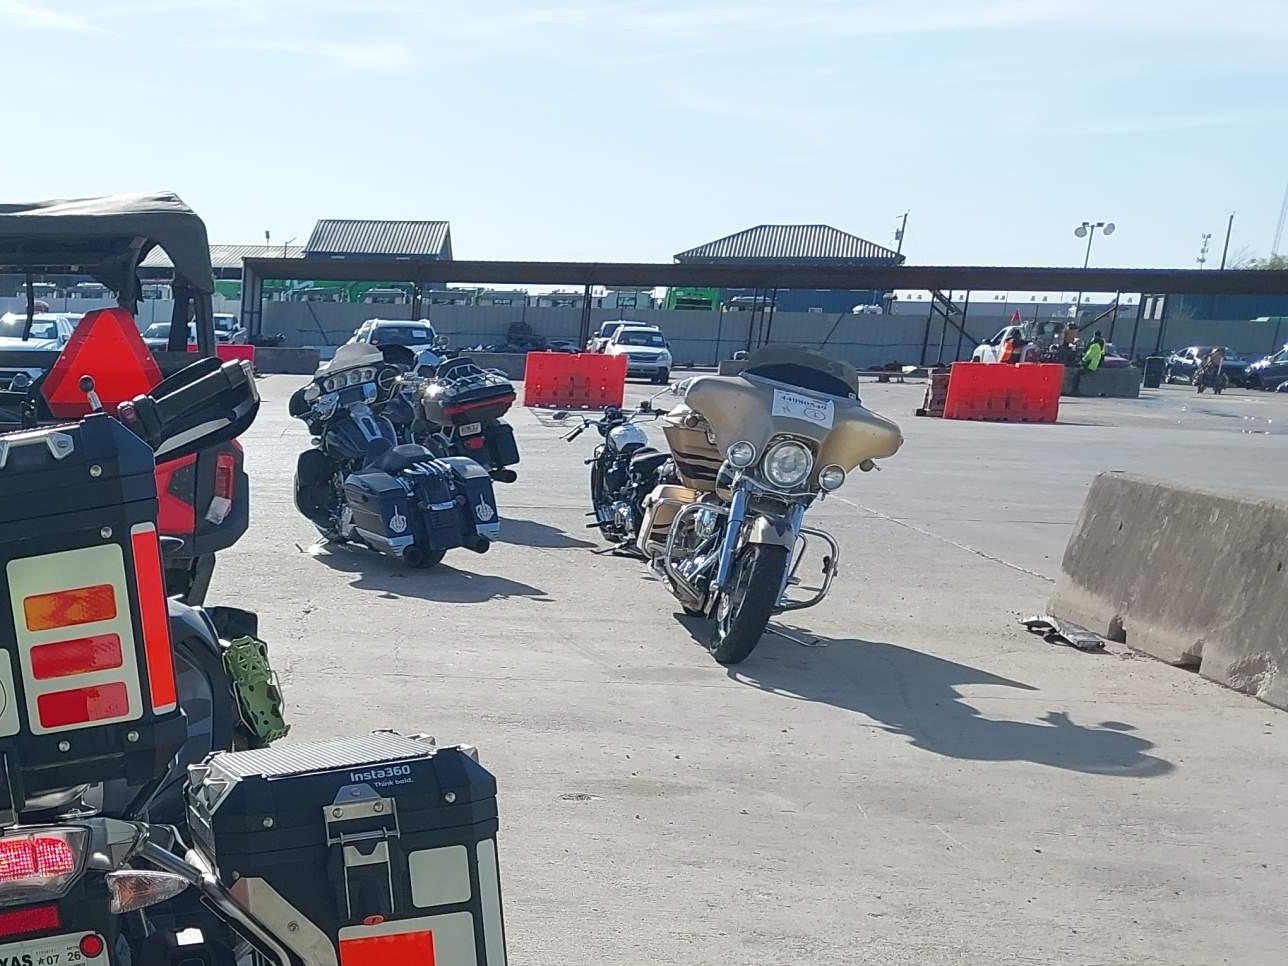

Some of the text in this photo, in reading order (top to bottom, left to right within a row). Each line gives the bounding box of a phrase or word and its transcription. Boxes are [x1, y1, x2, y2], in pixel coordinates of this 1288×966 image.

[350, 765, 410, 782] Insta360
[46, 954, 60, 966] 07
[67, 951, 81, 962] 26
